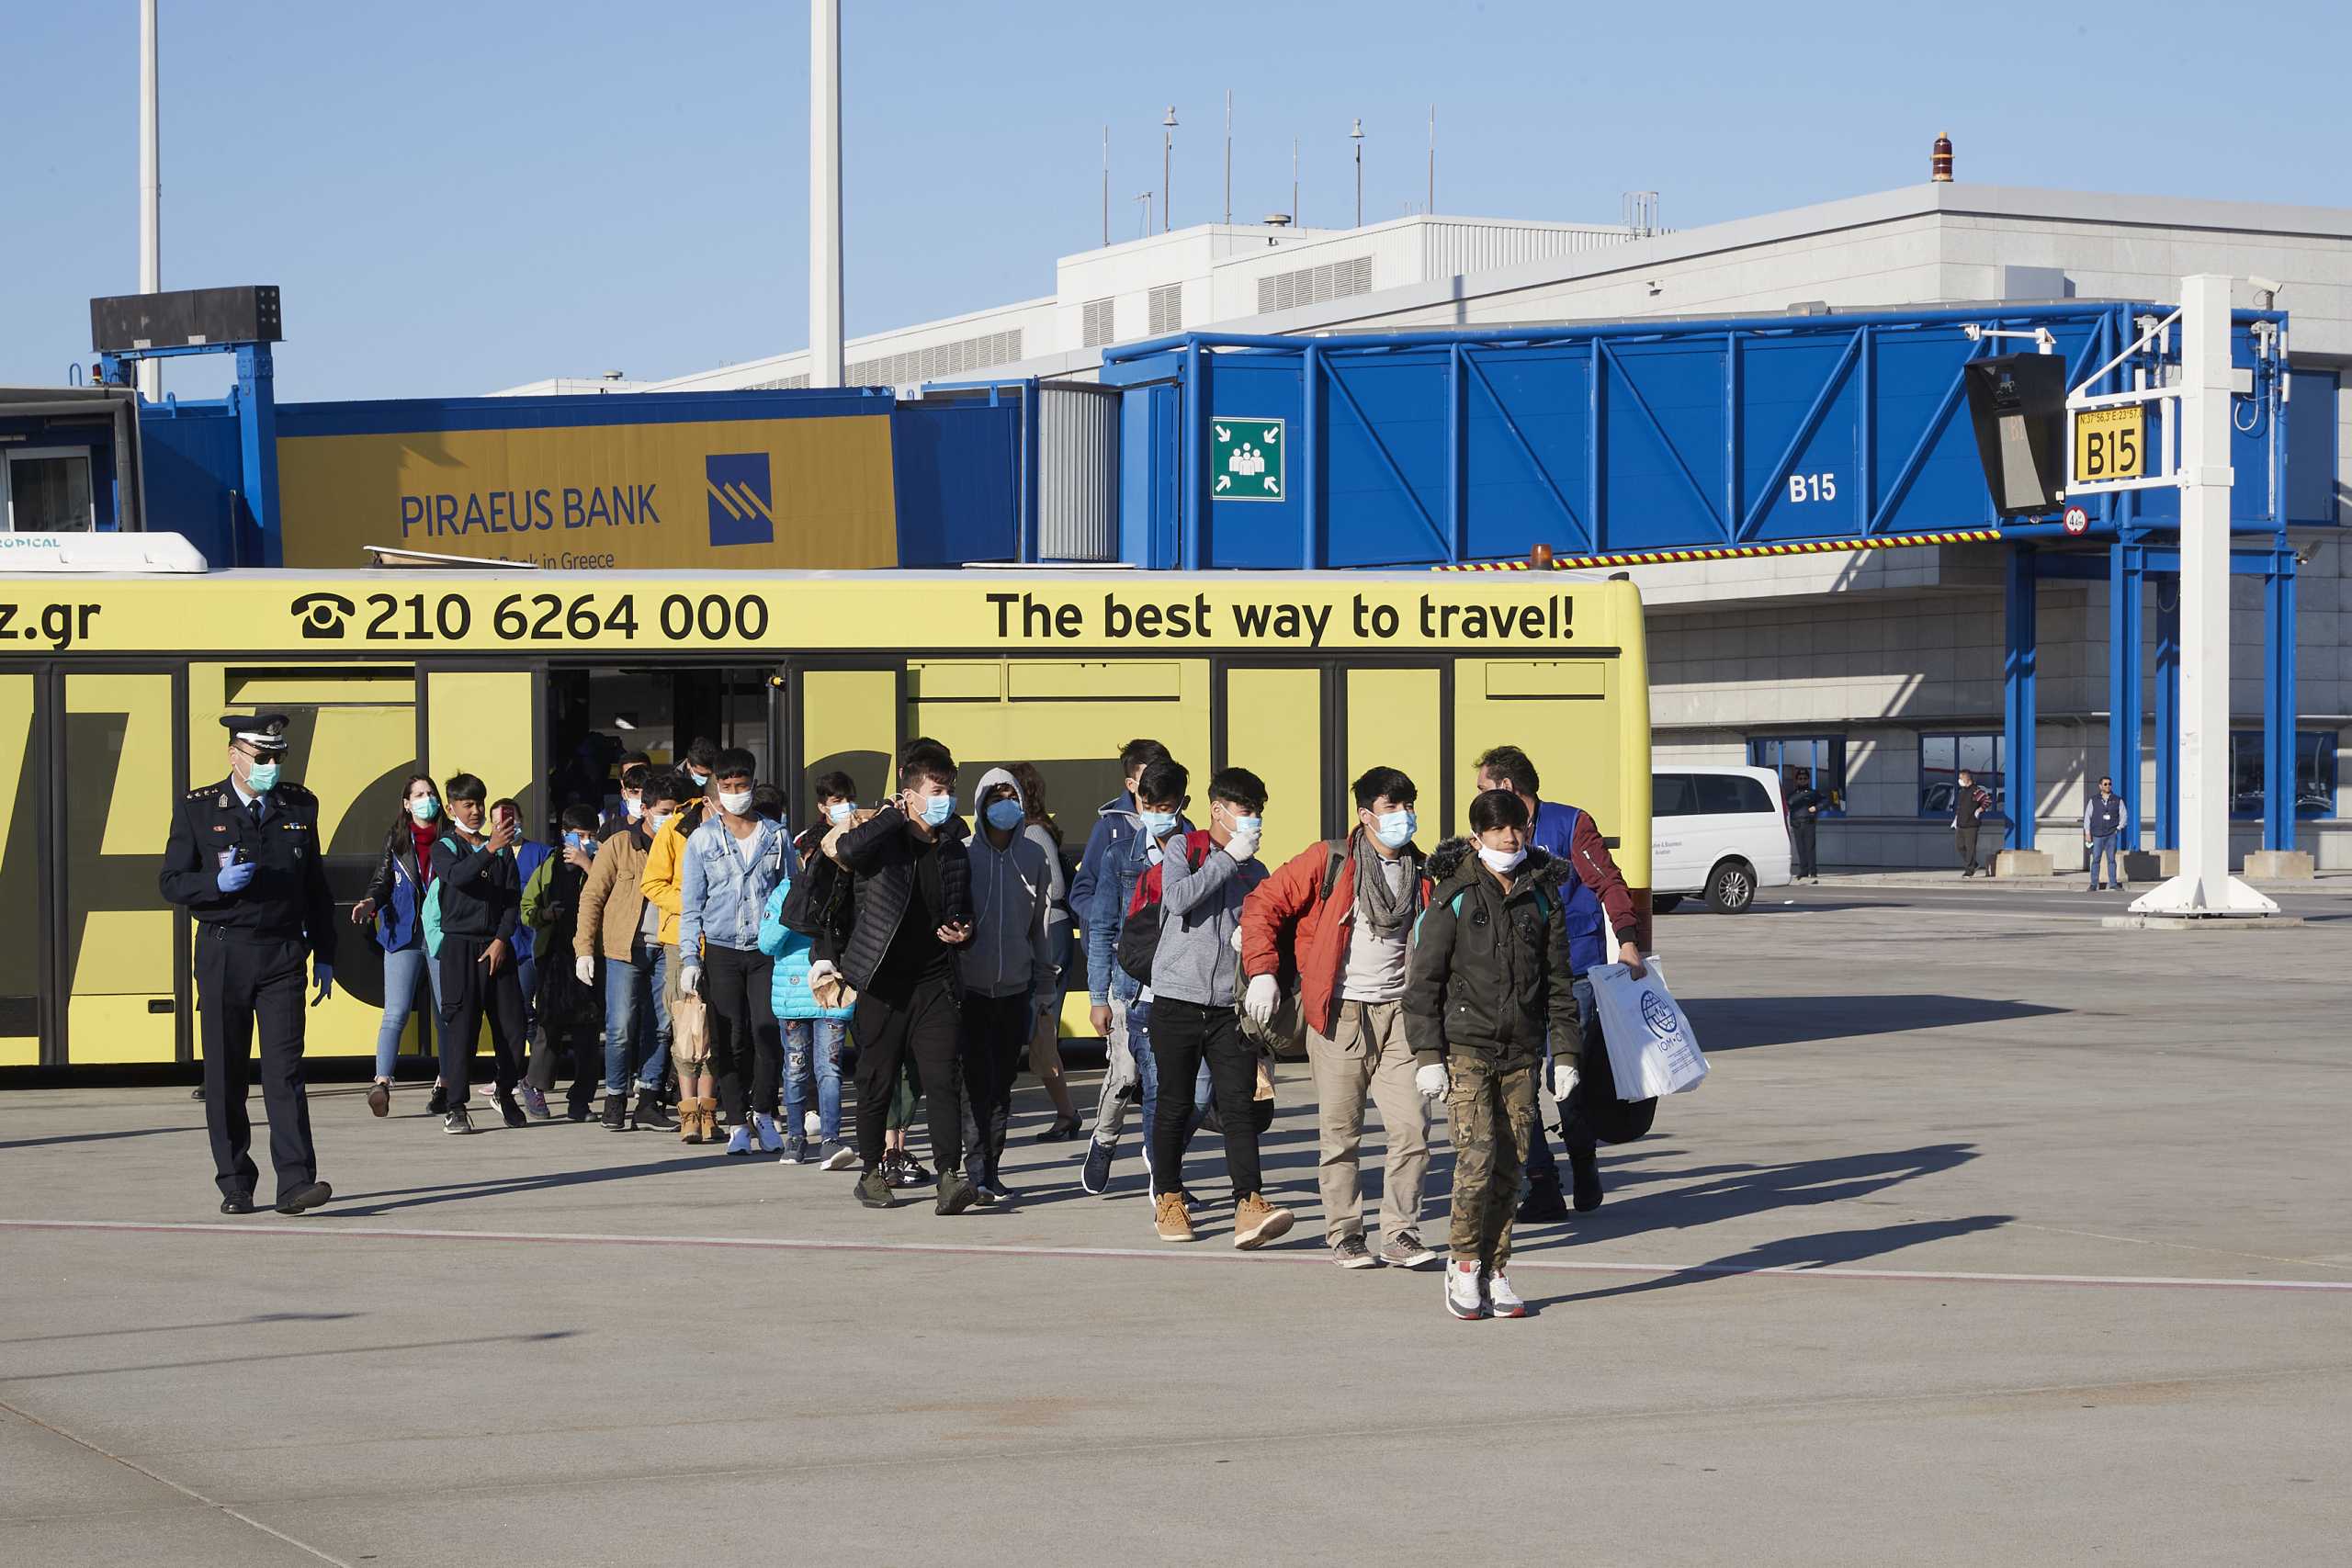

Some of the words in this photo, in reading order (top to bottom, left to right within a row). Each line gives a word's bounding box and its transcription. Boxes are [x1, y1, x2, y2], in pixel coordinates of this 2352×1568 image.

[2087, 428, 2136, 476] B15
[401, 489, 553, 537] PIRAEUS
[563, 484, 660, 528] BANK
[1790, 473, 1836, 502] B15
[543, 553, 557, 570] in
[561, 552, 615, 570] Greece
[366, 593, 470, 640] 210
[493, 593, 639, 640] 6264
[660, 593, 769, 640] 000
[986, 592, 1083, 638] The
[1104, 592, 1212, 638] best
[1232, 604, 1333, 648] way
[1352, 592, 1399, 638] to
[1419, 593, 1574, 639] travel!
